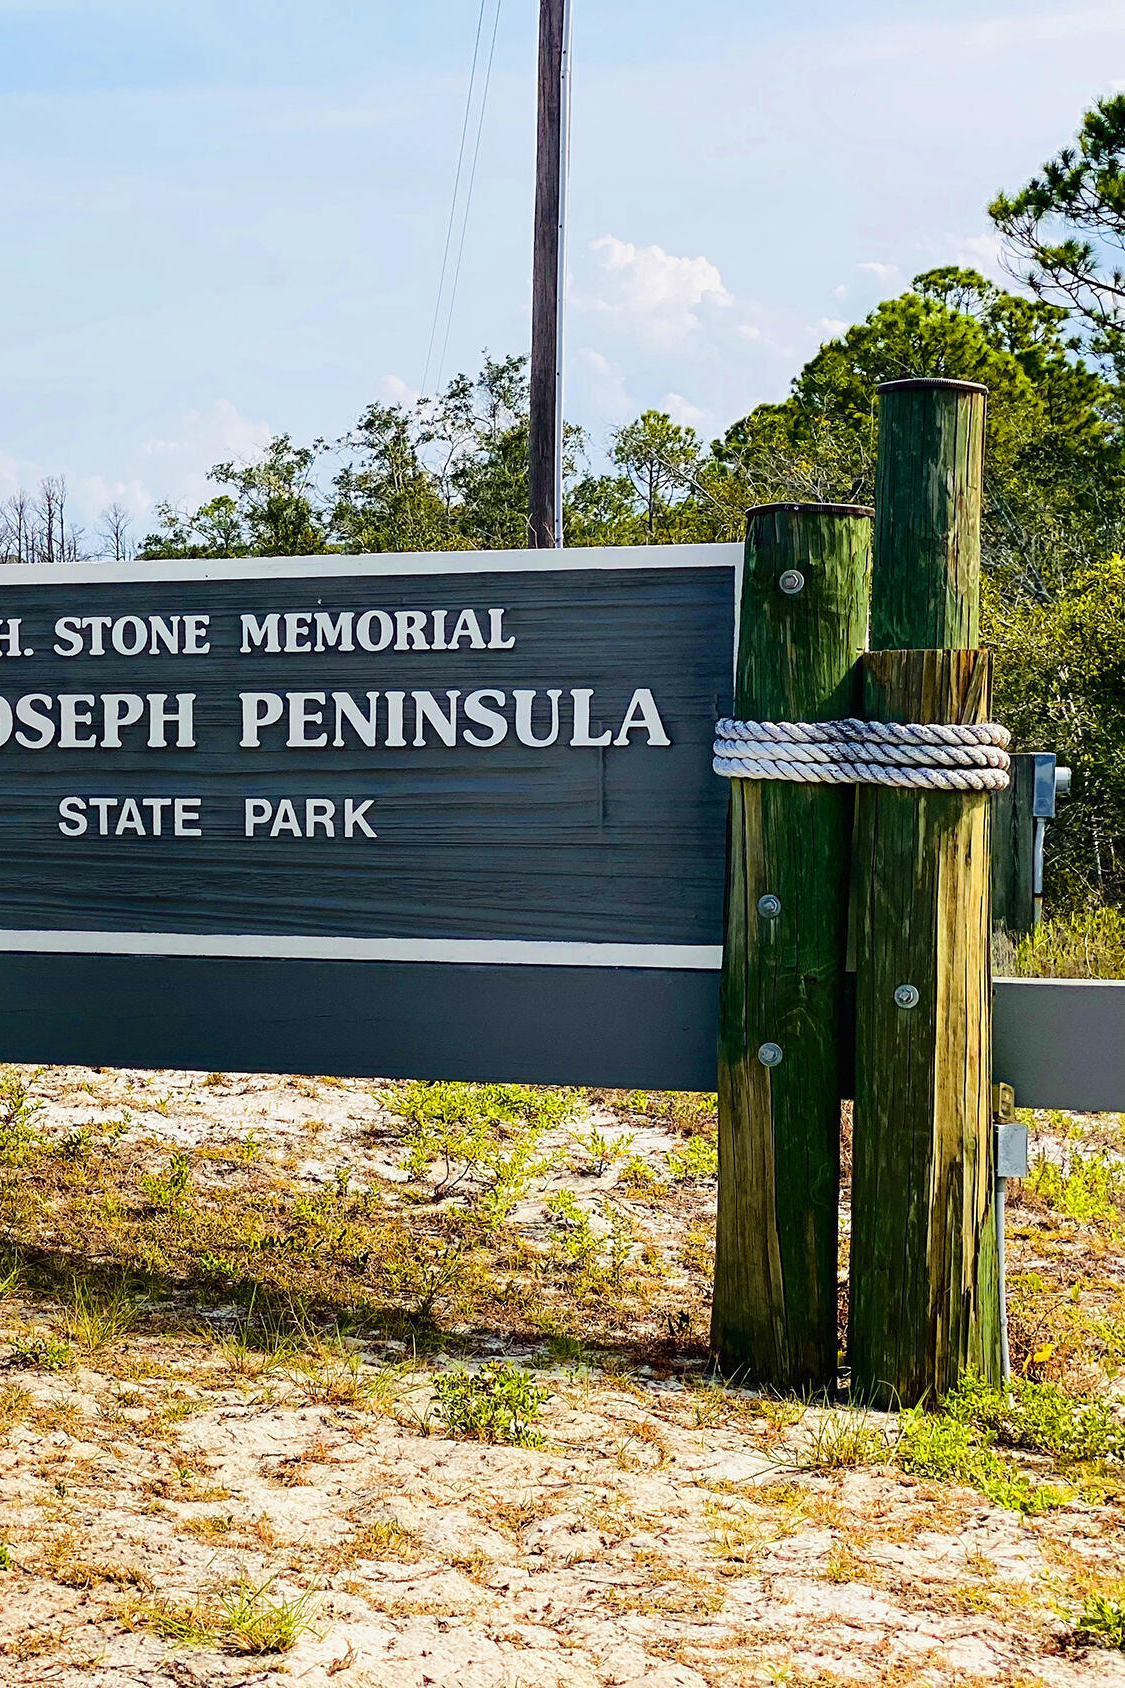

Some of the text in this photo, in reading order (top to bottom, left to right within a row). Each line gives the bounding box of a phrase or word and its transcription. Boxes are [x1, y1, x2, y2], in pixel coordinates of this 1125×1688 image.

[53, 615, 211, 657] STONE
[239, 608, 516, 653] MEMORIAL
[238, 688, 671, 748] PENINSULA
[58, 796, 378, 838] STATE PARK
